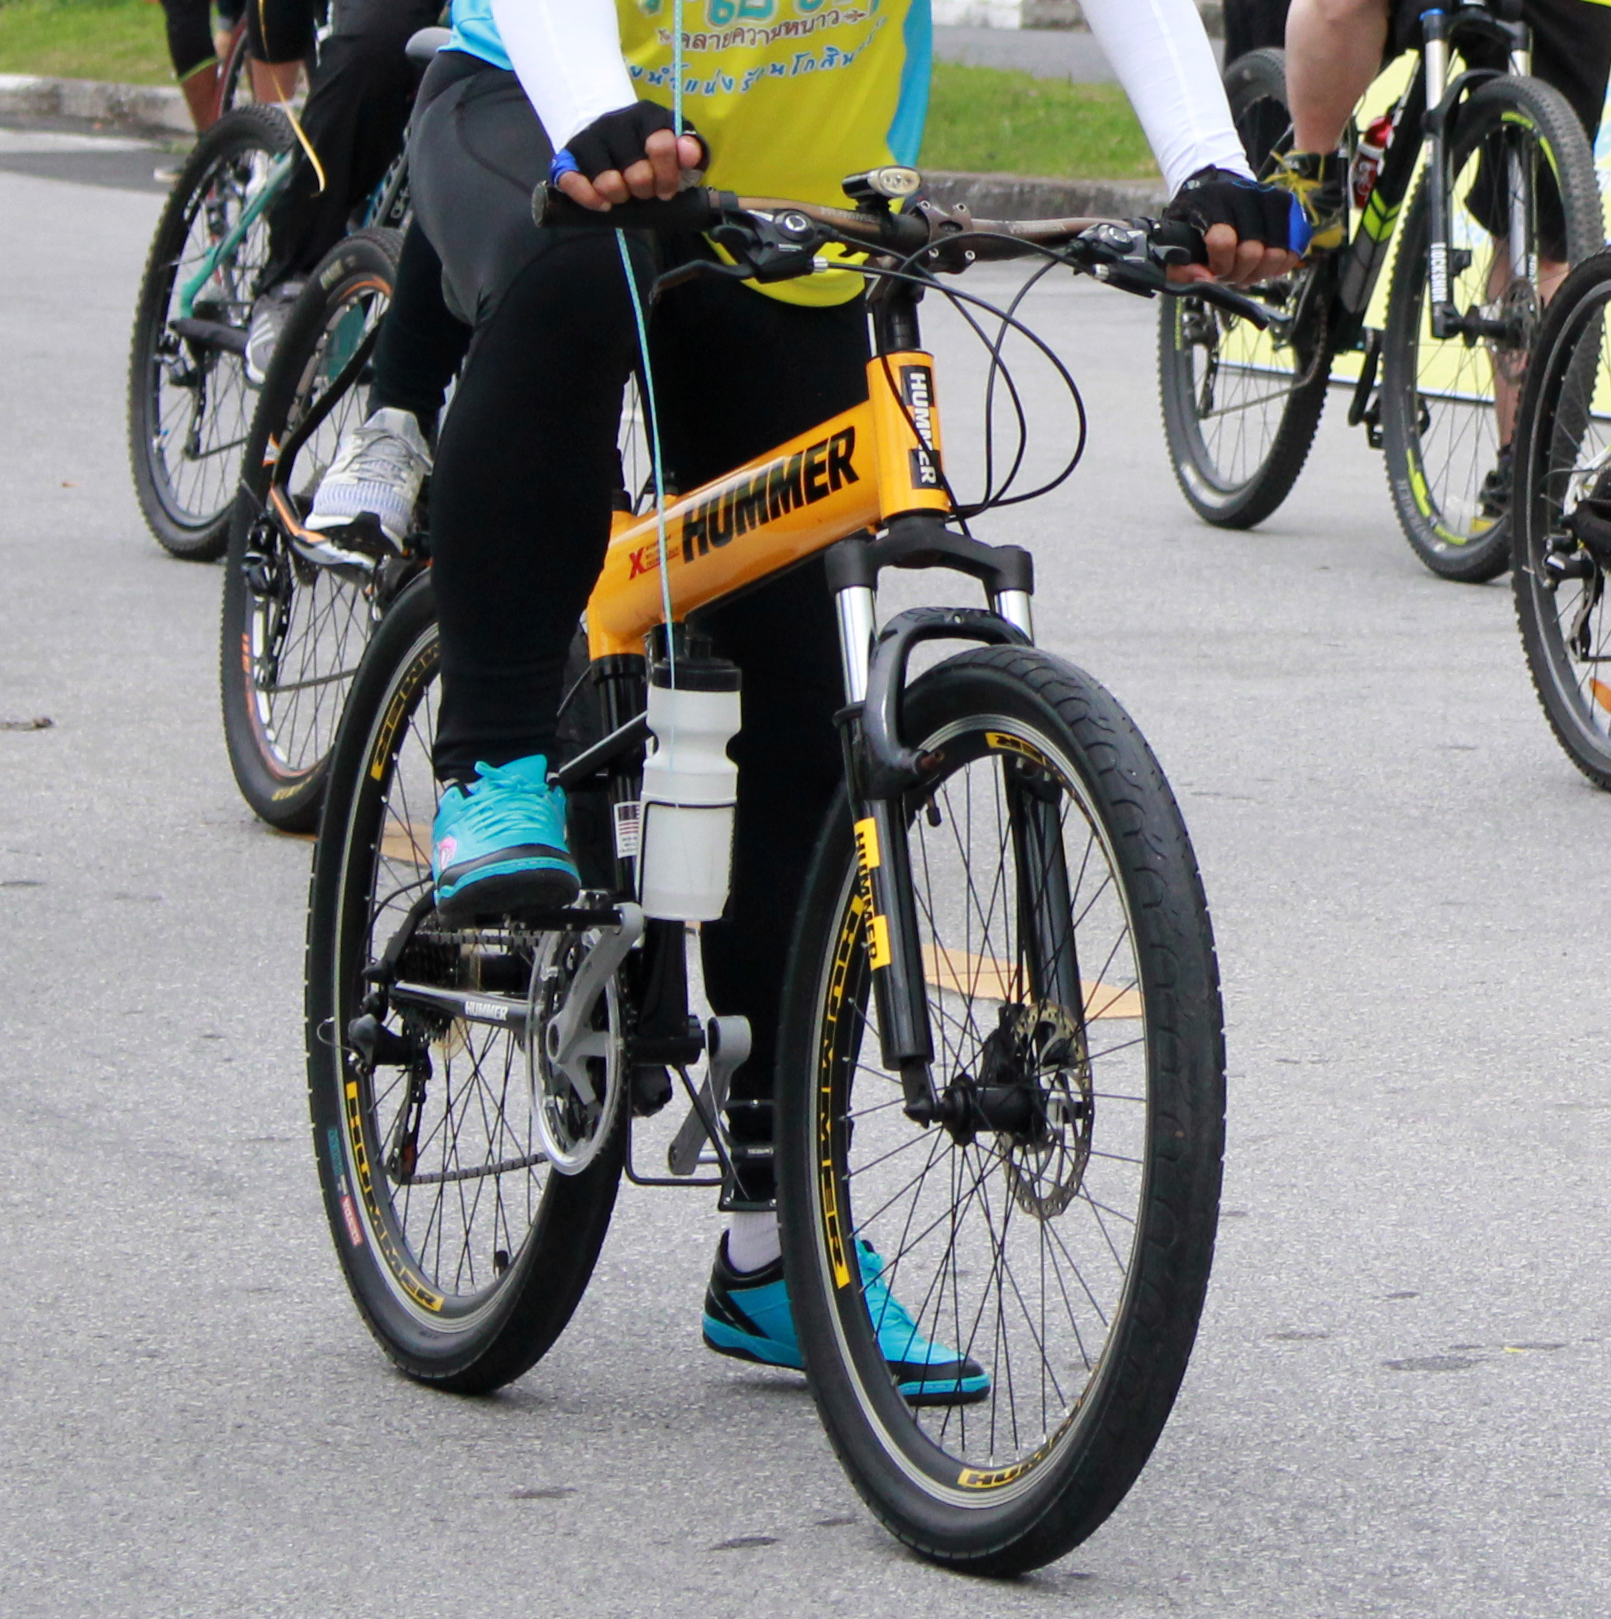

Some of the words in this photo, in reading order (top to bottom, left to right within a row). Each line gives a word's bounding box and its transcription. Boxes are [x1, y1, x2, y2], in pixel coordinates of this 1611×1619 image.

[909, 370, 938, 485] HUMMER
[681, 425, 861, 565] HUMMER
[464, 999, 509, 1023] HUMMER
